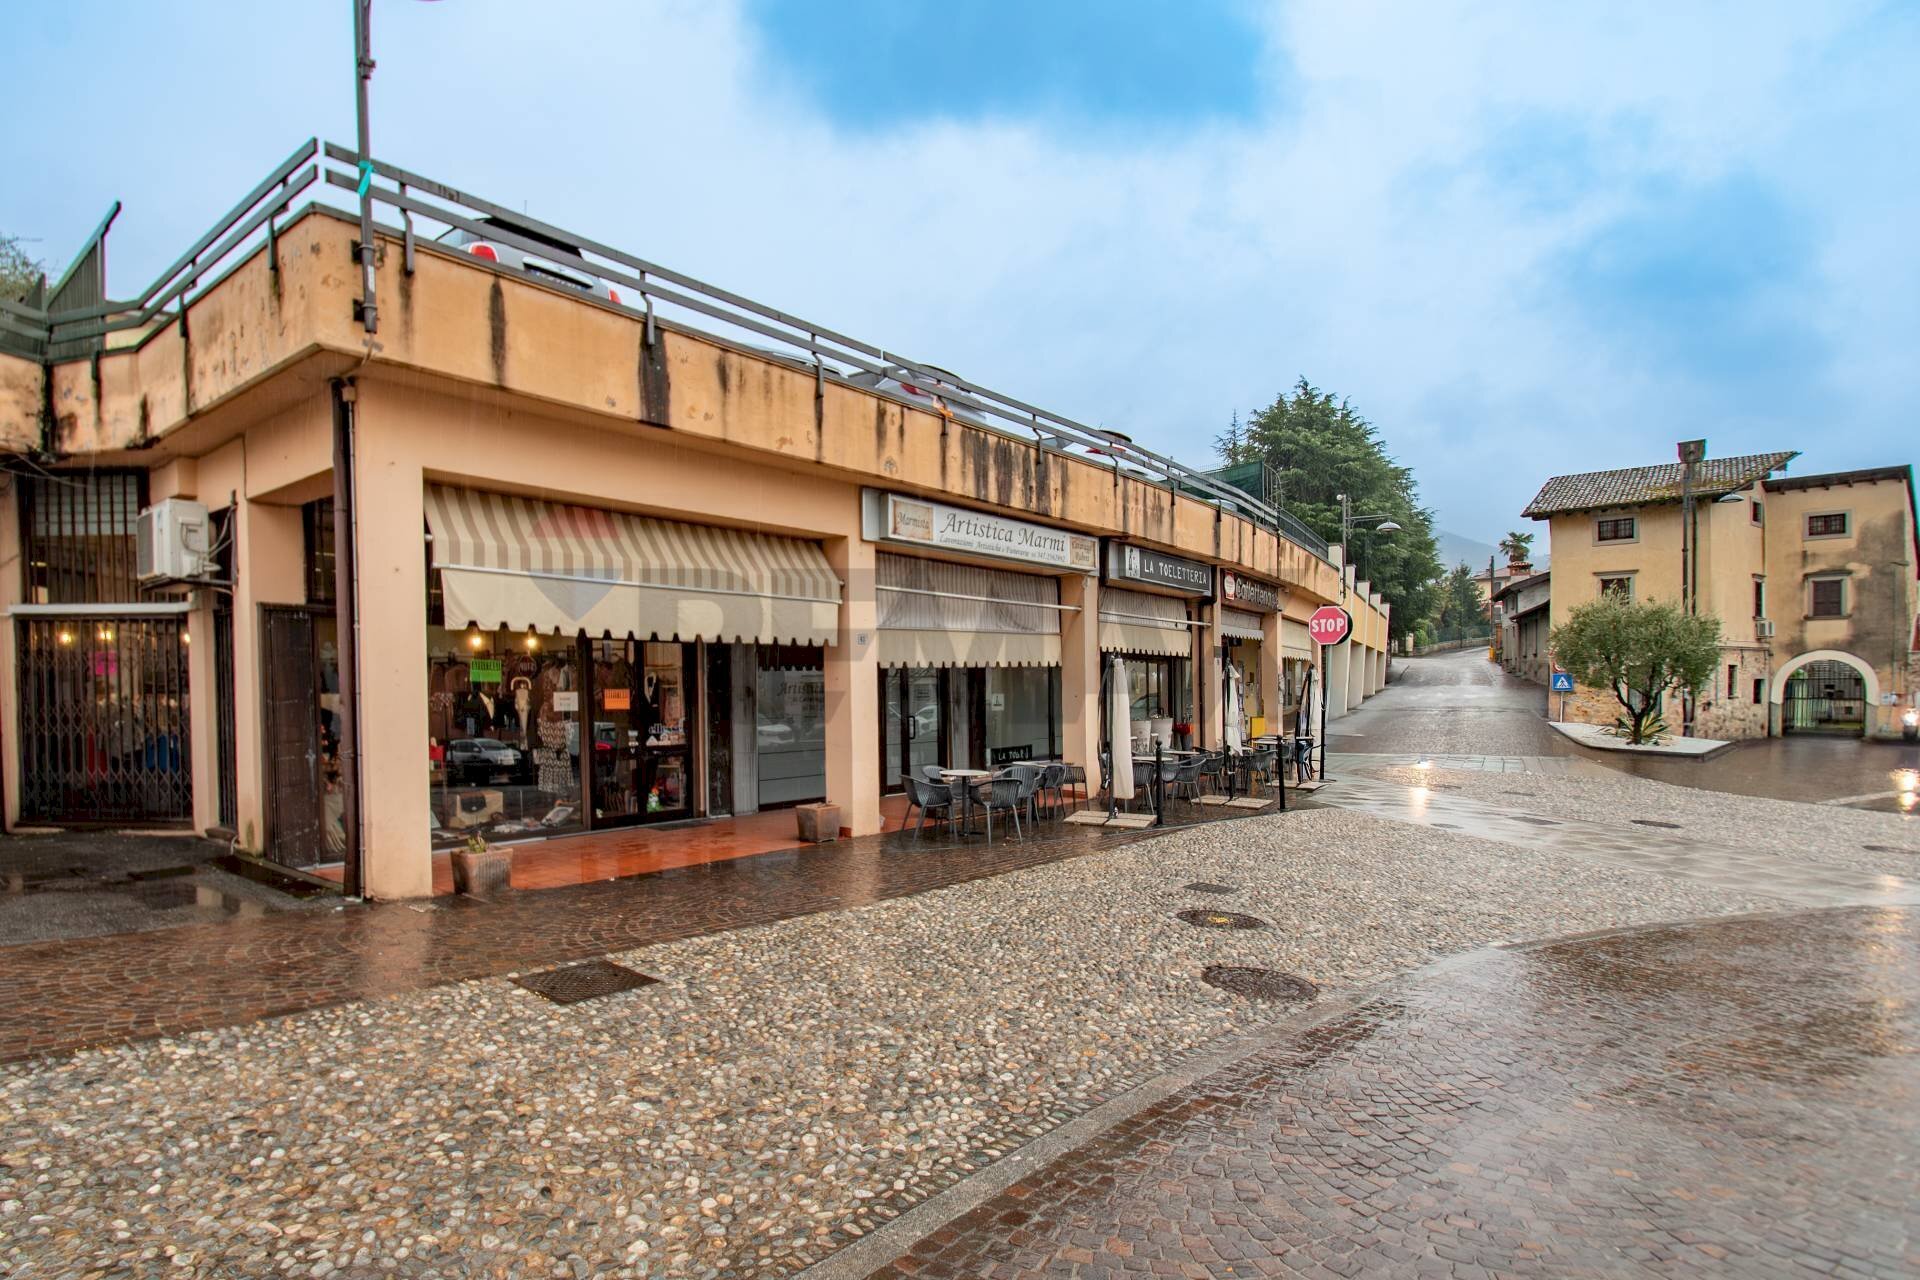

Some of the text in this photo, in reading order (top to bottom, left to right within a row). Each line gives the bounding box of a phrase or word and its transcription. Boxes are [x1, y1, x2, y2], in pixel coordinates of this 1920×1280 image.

[940, 512, 1066, 552] Artistica Marmi
[1144, 559, 1154, 574] LA
[1158, 561, 1207, 585] TOELETTERIA
[1311, 617, 1345, 633] STOP
